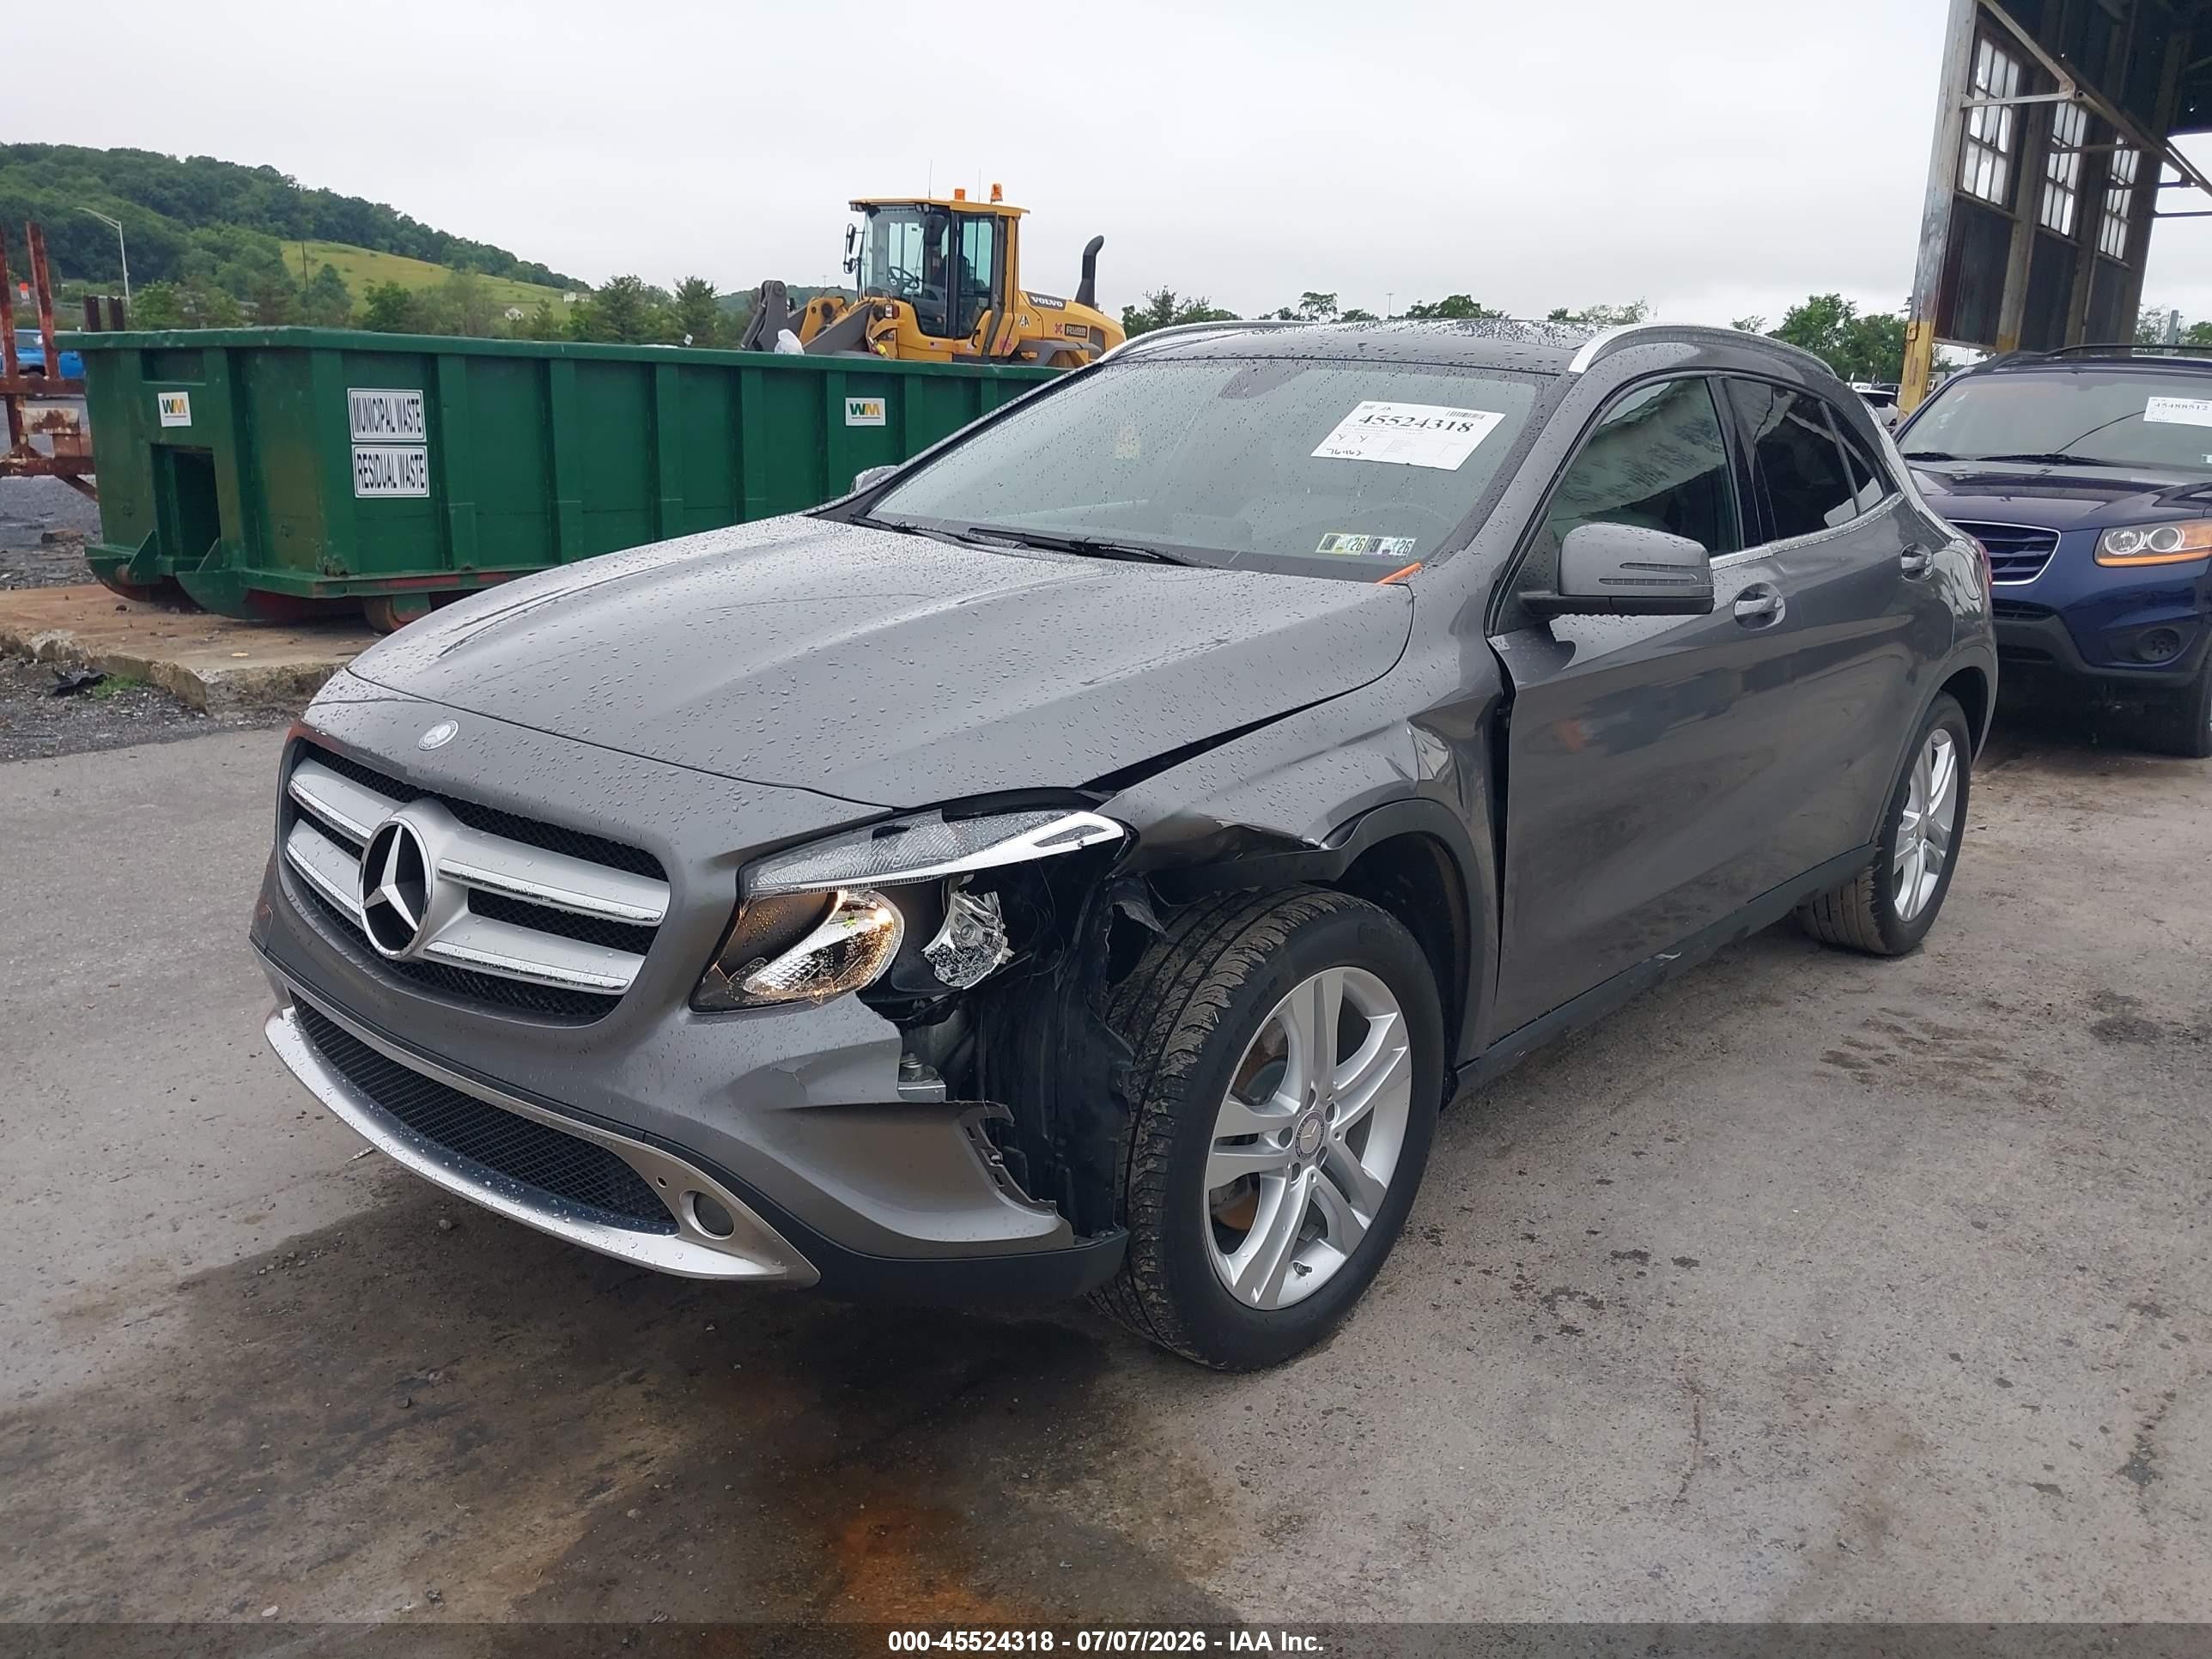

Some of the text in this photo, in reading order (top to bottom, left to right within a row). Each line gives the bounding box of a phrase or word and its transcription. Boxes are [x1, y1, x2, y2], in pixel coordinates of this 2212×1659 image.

[1031, 296, 1064, 307] VOLVO
[161, 398, 186, 414] WM
[849, 403, 880, 416] WM
[352, 398, 422, 433] MUNICIPAL WASTE
[1358, 414, 1474, 434] 45524318
[356, 453, 425, 489] RESIDUAL WASTE
[1350, 538, 1365, 551] 26
[1397, 539, 1413, 554] 26
